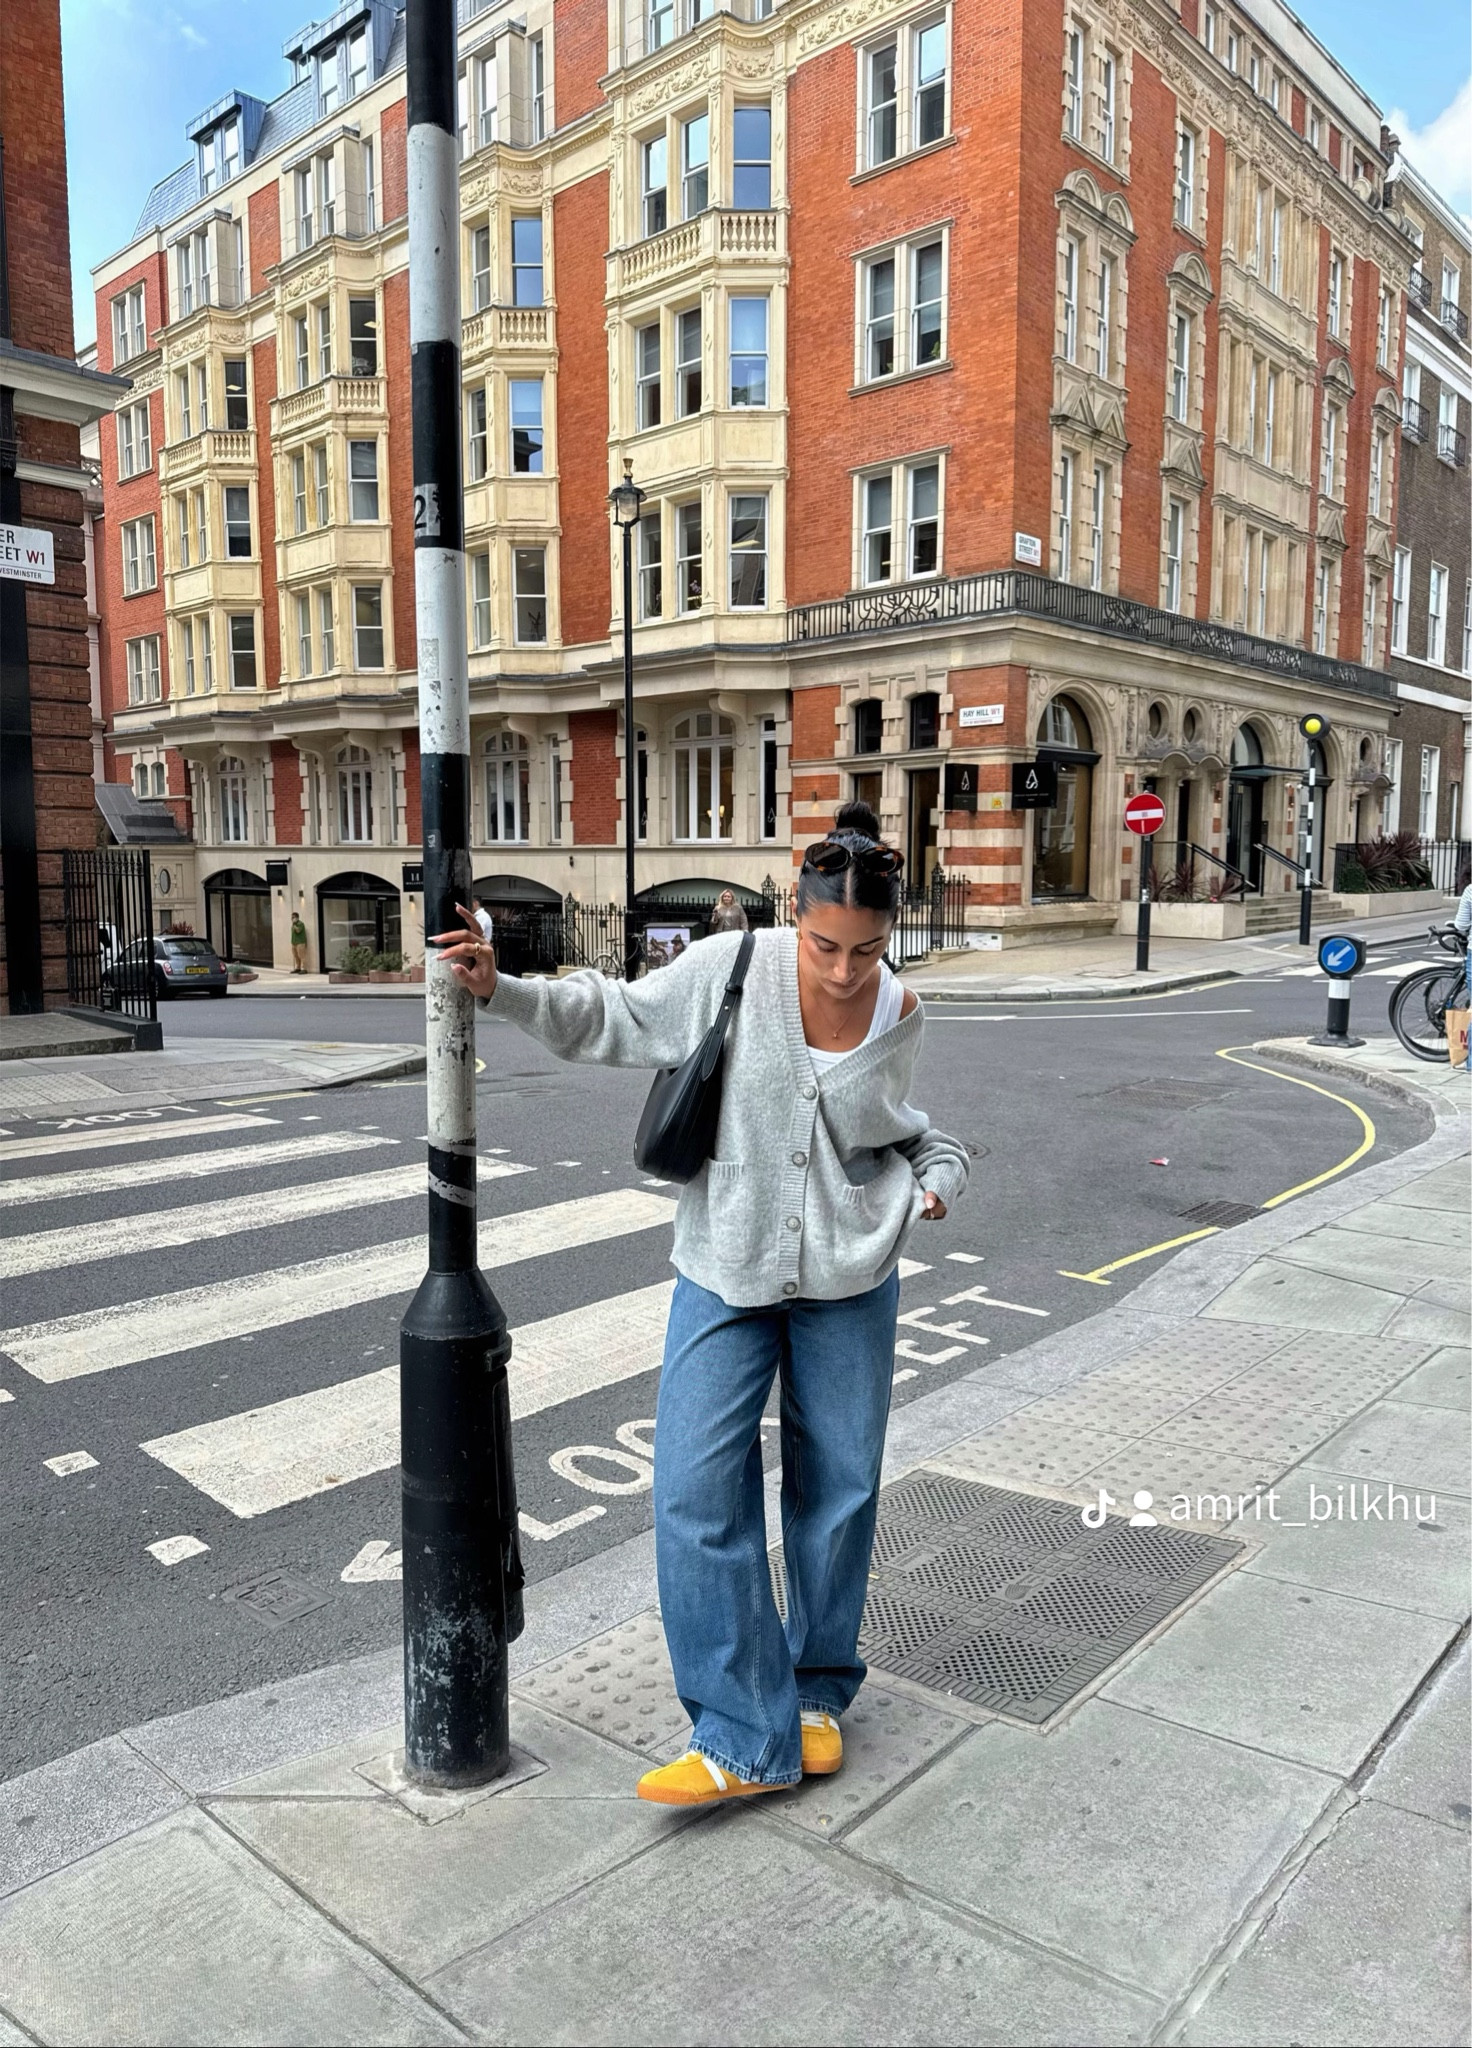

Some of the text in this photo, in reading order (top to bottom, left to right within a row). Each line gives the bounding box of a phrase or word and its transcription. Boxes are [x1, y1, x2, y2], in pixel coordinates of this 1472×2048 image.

[26, 549, 45, 565] W1
[1018, 545, 1033, 555] STREET
[37, 1106, 198, 1129] LOOK
